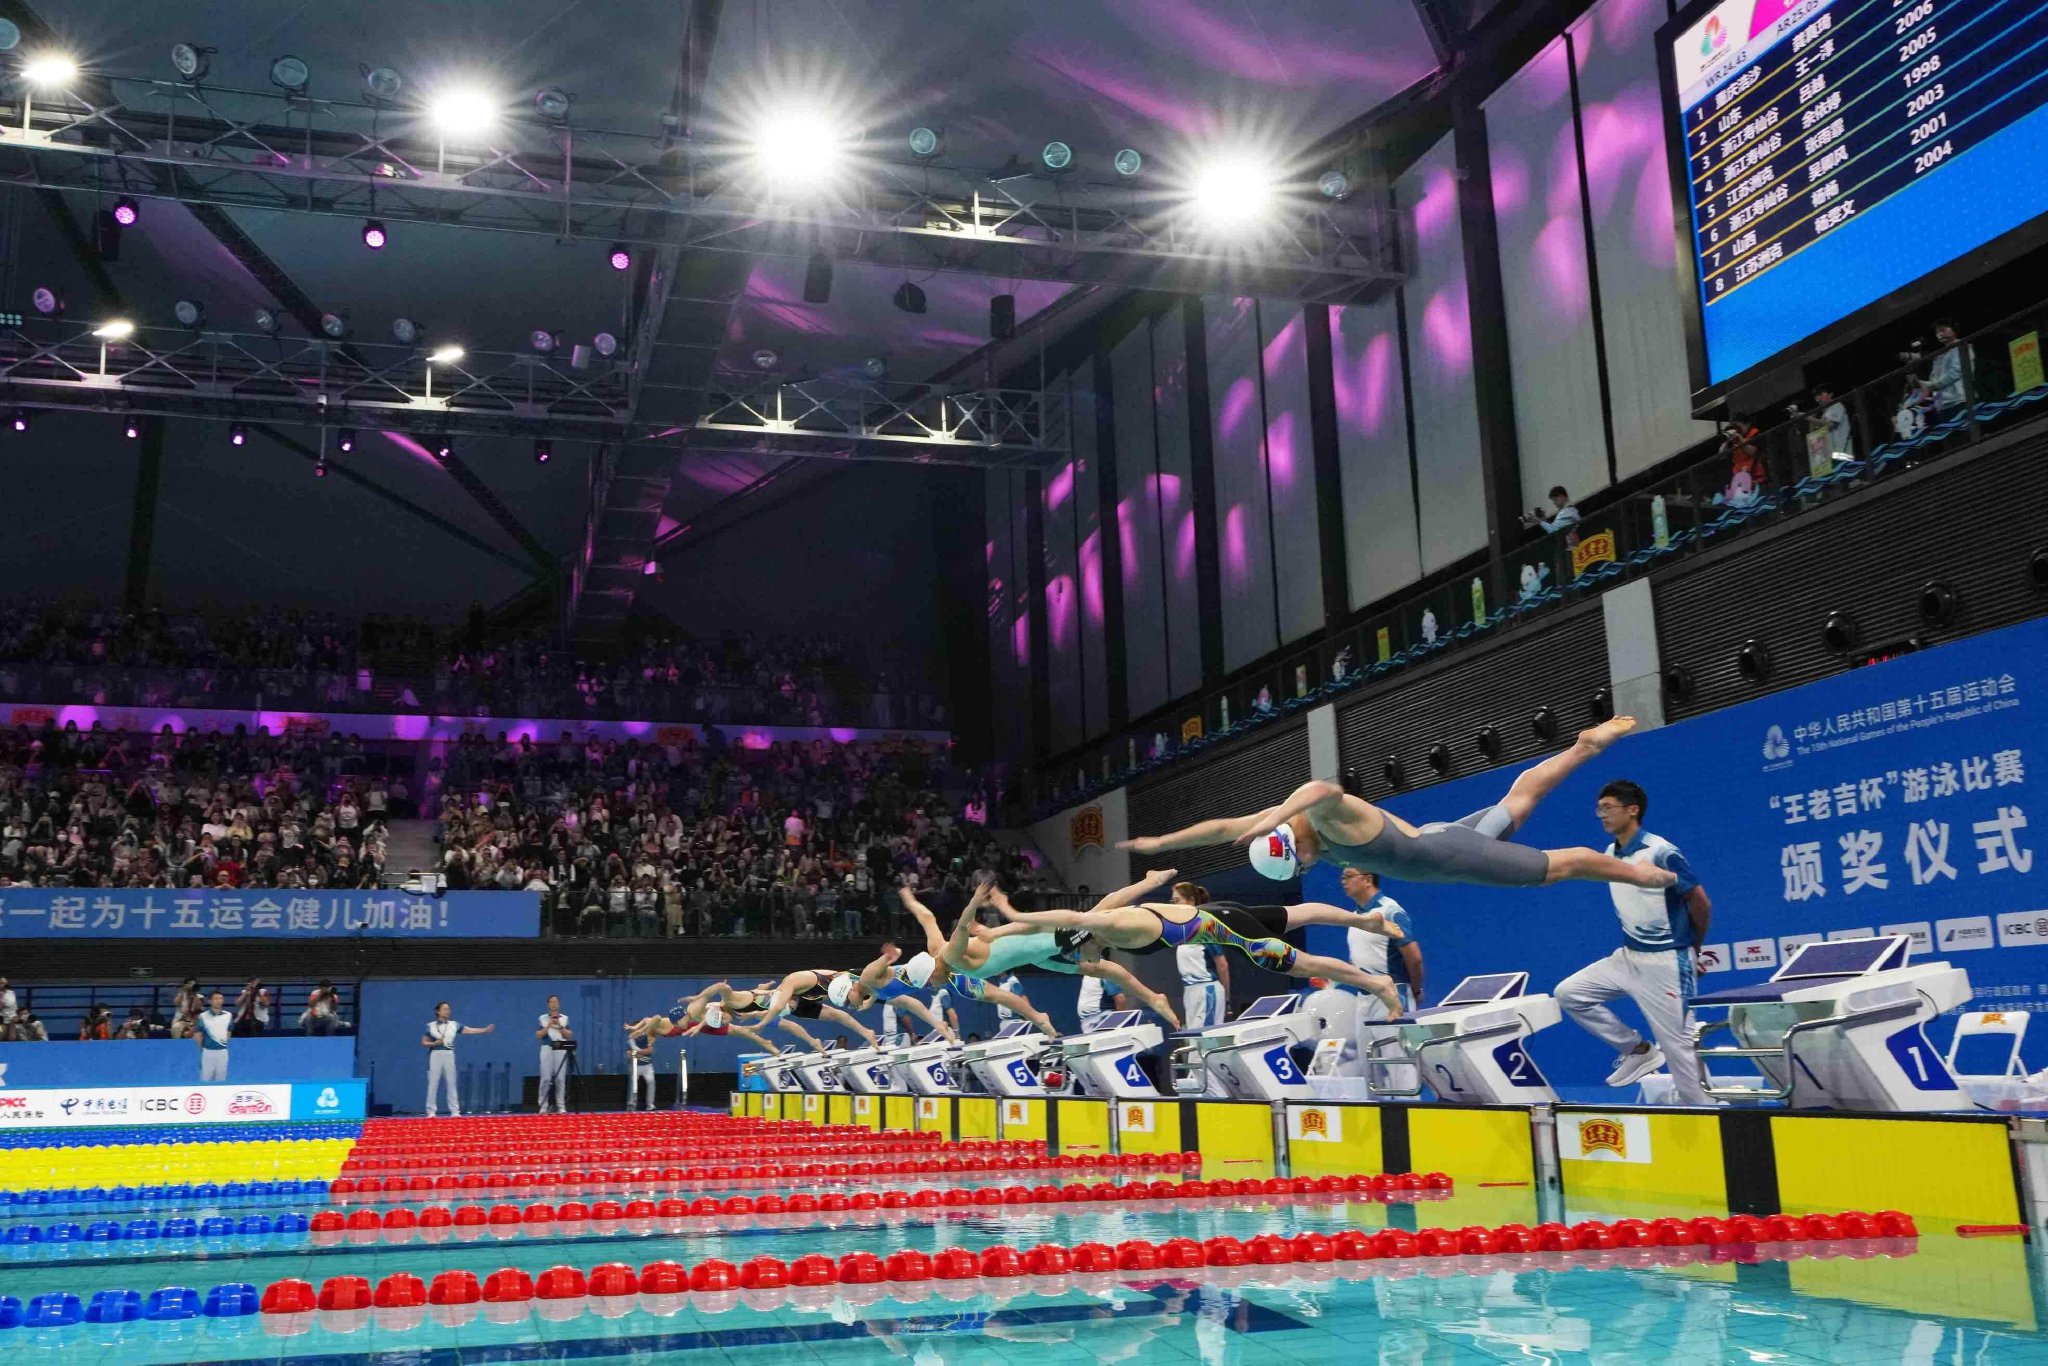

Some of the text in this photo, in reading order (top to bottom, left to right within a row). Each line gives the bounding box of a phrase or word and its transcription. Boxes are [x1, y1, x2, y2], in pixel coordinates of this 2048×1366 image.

[1699, 38, 1835, 145] 2 山东 王一淳
[1702, 156, 1710, 169] 3
[1895, 0, 1933, 35] 2006
[1697, 107, 1704, 120] 1
[1705, 179, 1713, 192] 4
[1898, 26, 1937, 62] 2005
[1707, 203, 1716, 218] 5
[1805, 117, 1845, 155] 张雨霏
[1902, 55, 1941, 88] 1998
[1710, 228, 1718, 242] 6
[1906, 83, 1945, 118] 2003
[1712, 252, 1721, 267] 7
[1732, 230, 1757, 256] 山西
[1909, 111, 1947, 146] 2001
[1715, 278, 1724, 292] 8
[1914, 139, 1953, 174] 2004
[1793, 673, 2016, 743] 中华人民共和国第十五届运动会
[1796, 745, 1811, 756] The
[1828, 735, 1859, 749] National
[1860, 729, 1886, 742] Games
[1886, 724, 1896, 735] of
[1896, 721, 1910, 733] the
[1945, 706, 1982, 722] Republic
[1983, 702, 1993, 713] of
[1993, 698, 2020, 711] China
[1780, 805, 2033, 902] 颁奖仪式
[0, 896, 448, 930] 一起为十五运会健儿加油！
[2004, 923, 2032, 936] ICBC
[932, 1067, 945, 1082] 6
[1015, 1065, 1028, 1084] 5
[1126, 1063, 1140, 1082] 4
[1275, 1057, 1294, 1081] 3
[1508, 1052, 1527, 1080] 2
[1907, 1046, 1929, 1081] 1
[139, 1098, 179, 1111] ICBC
